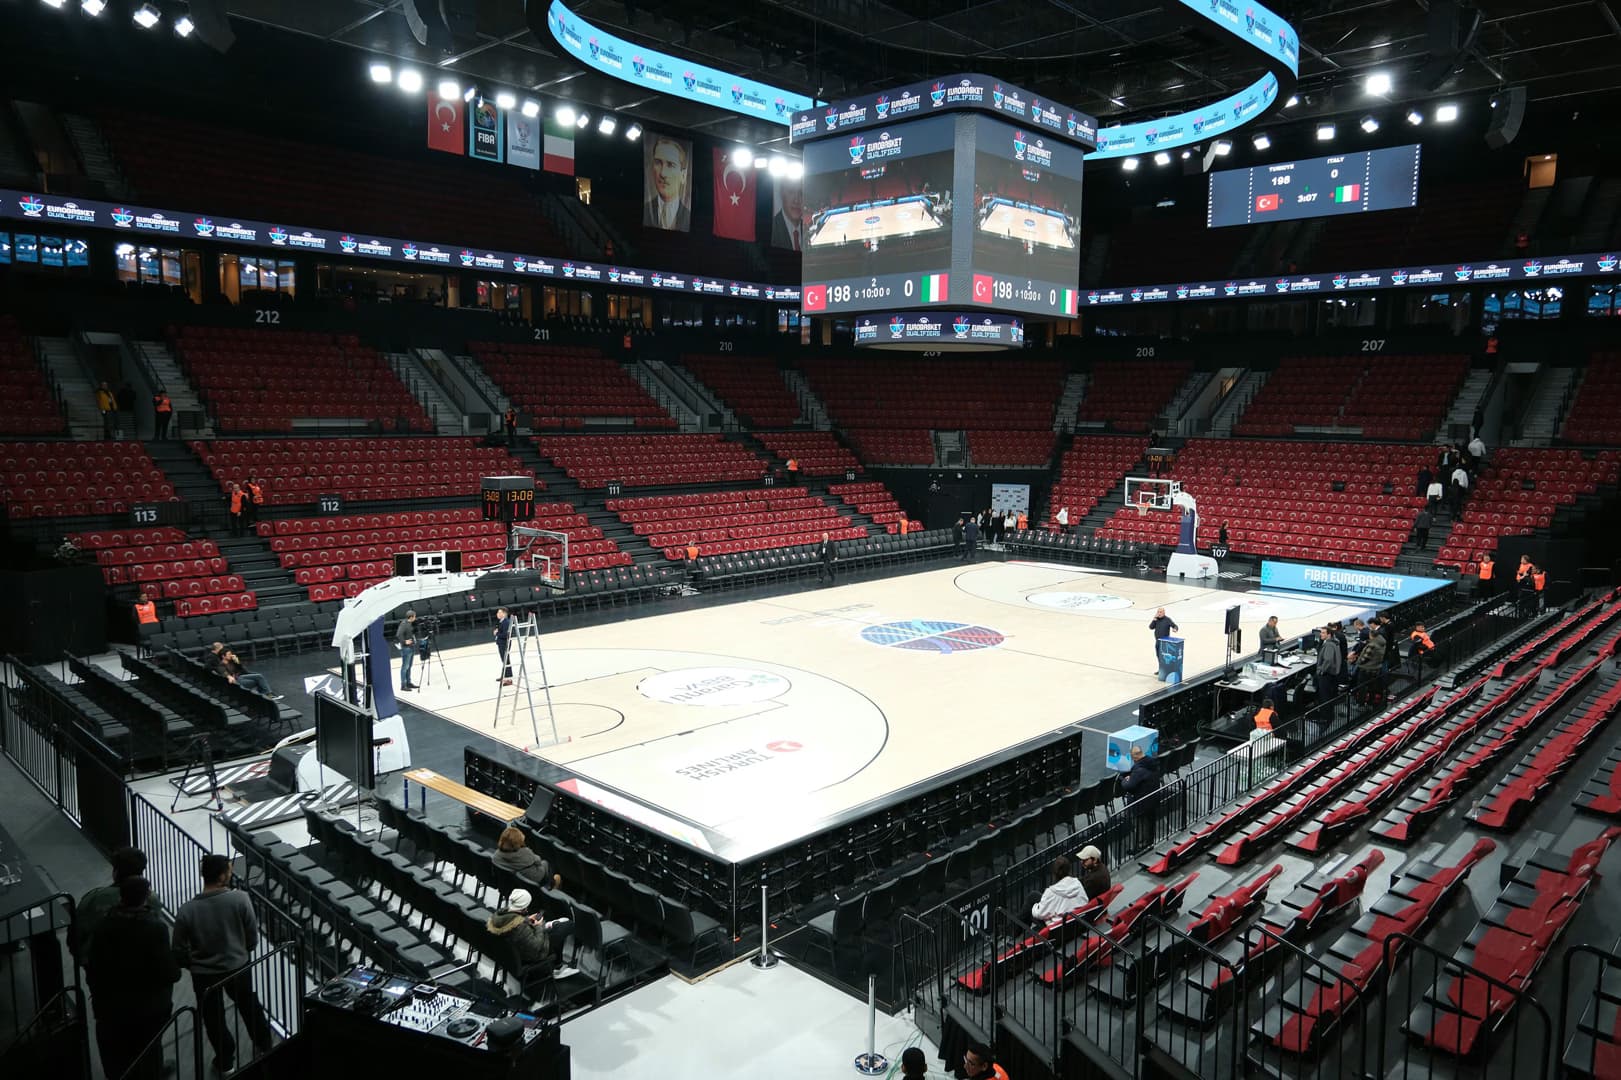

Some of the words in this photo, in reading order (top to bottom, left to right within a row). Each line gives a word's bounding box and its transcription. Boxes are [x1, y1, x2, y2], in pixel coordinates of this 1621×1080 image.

[948, 87, 983, 96] EUROBASKET
[478, 132, 495, 144] FIBA
[867, 138, 902, 152] EUROBASKET
[867, 147, 901, 160] QUALIFIERS
[1330, 169, 1338, 178] 0
[1272, 176, 1290, 186] 198
[1297, 193, 1318, 203] 3:07
[47, 206, 95, 216] EUROBASKET
[872, 278, 877, 287] 2
[904, 280, 913, 296] 0
[1028, 280, 1032, 290] 2
[827, 285, 850, 302] 198
[855, 290, 860, 298] 0
[862, 287, 884, 298] 10:00
[886, 288, 890, 296] 0
[993, 280, 1012, 300] 198
[1020, 290, 1036, 300] 10:00
[1050, 290, 1056, 306] 0
[256, 310, 280, 324] 212
[534, 329, 550, 340] 211
[720, 341, 733, 352] 210
[1361, 340, 1386, 352] 207
[1136, 347, 1155, 358] 208
[608, 486, 620, 496] 111
[322, 501, 340, 512] 112
[134, 510, 157, 522] 113
[1212, 548, 1227, 558] 107
[1304, 568, 1328, 581] FIBA
[1330, 571, 1402, 591] EUROBASKET
[675, 749, 758, 776] AIRLINES
[688, 754, 775, 781] TURKISH
[960, 904, 988, 942] 101
